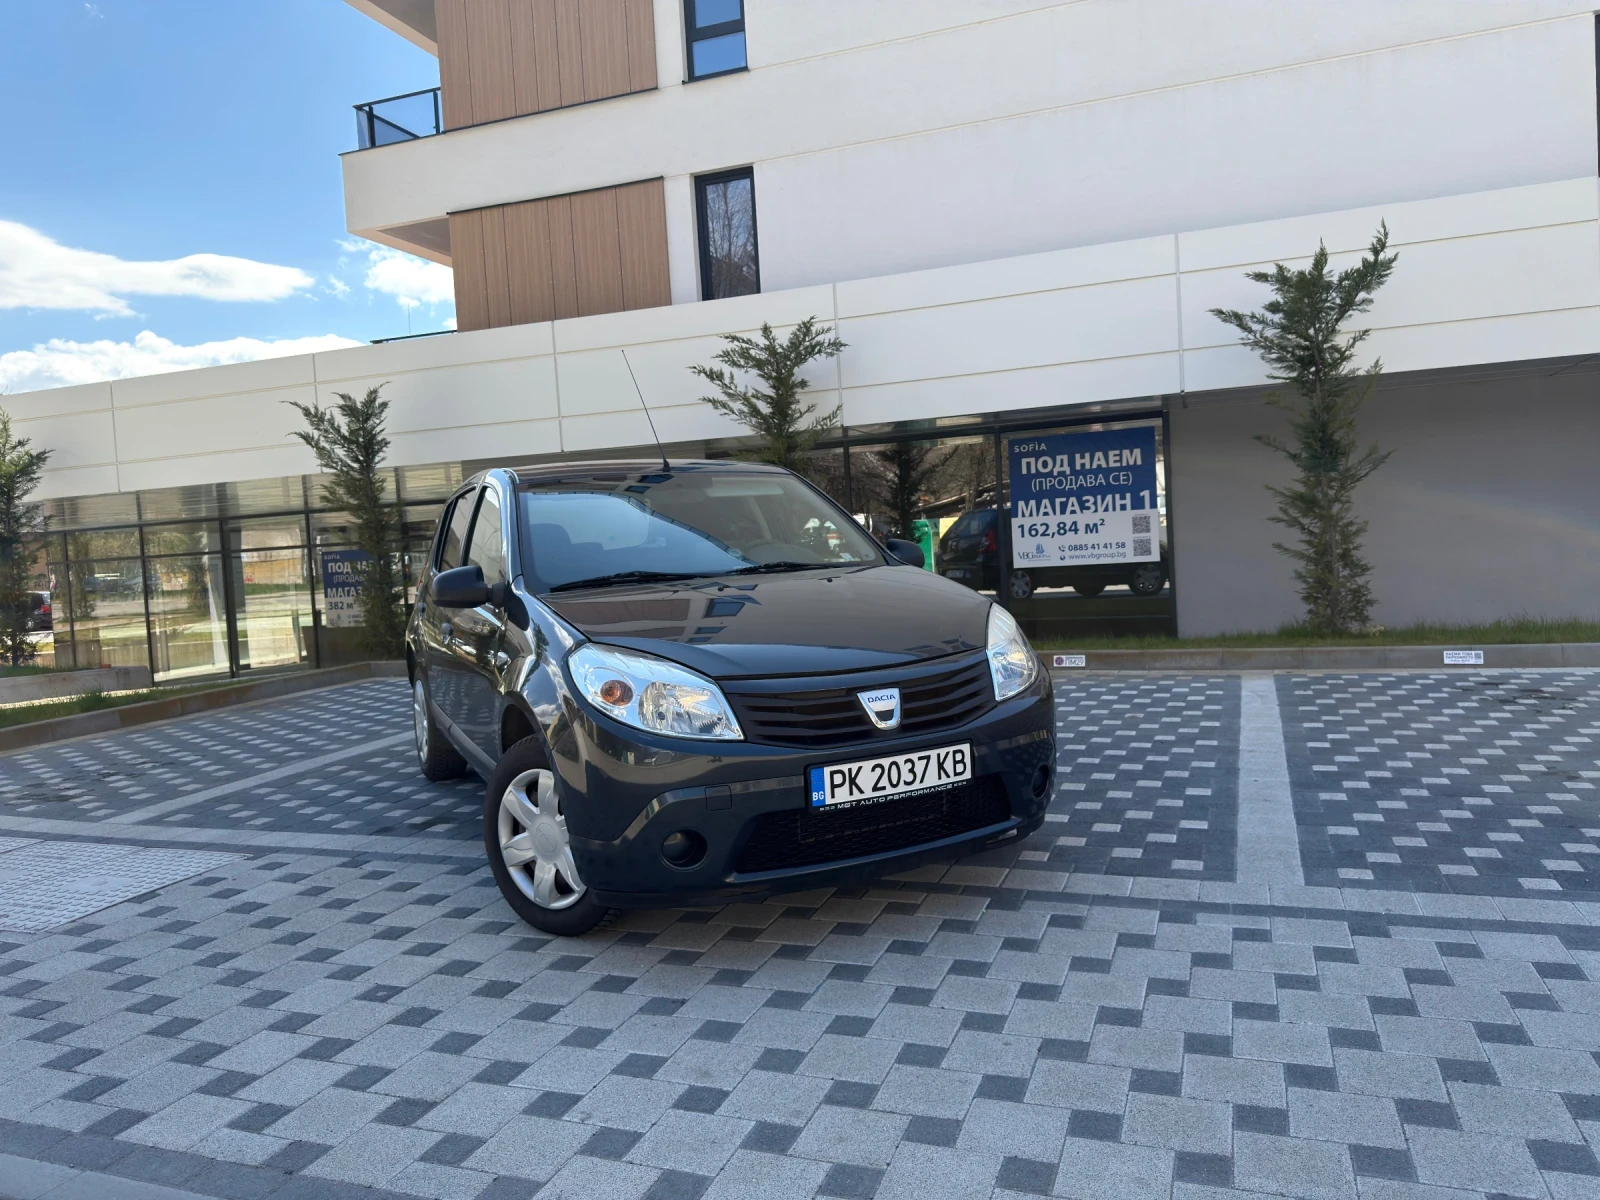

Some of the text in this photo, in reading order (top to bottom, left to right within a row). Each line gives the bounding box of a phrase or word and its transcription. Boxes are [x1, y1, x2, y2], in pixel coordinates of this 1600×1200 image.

[1021, 448, 1142, 476] ПОД НАЕМ
[1031, 472, 1133, 492] (ПРОДАВА СЕ)
[1017, 490, 1150, 518] МАГАЗИН 1
[1017, 521, 1080, 538] 162,84
[1068, 552, 1126, 560] www.vbgroup.bg
[328, 562, 352, 574] ПОД
[328, 601, 344, 610] 382
[867, 694, 896, 704] DACIA
[830, 748, 967, 800] PK 2037 KB
[812, 792, 824, 800] BG
[860, 797, 886, 806] AUTO
[886, 784, 952, 802] PERFORMANCE
